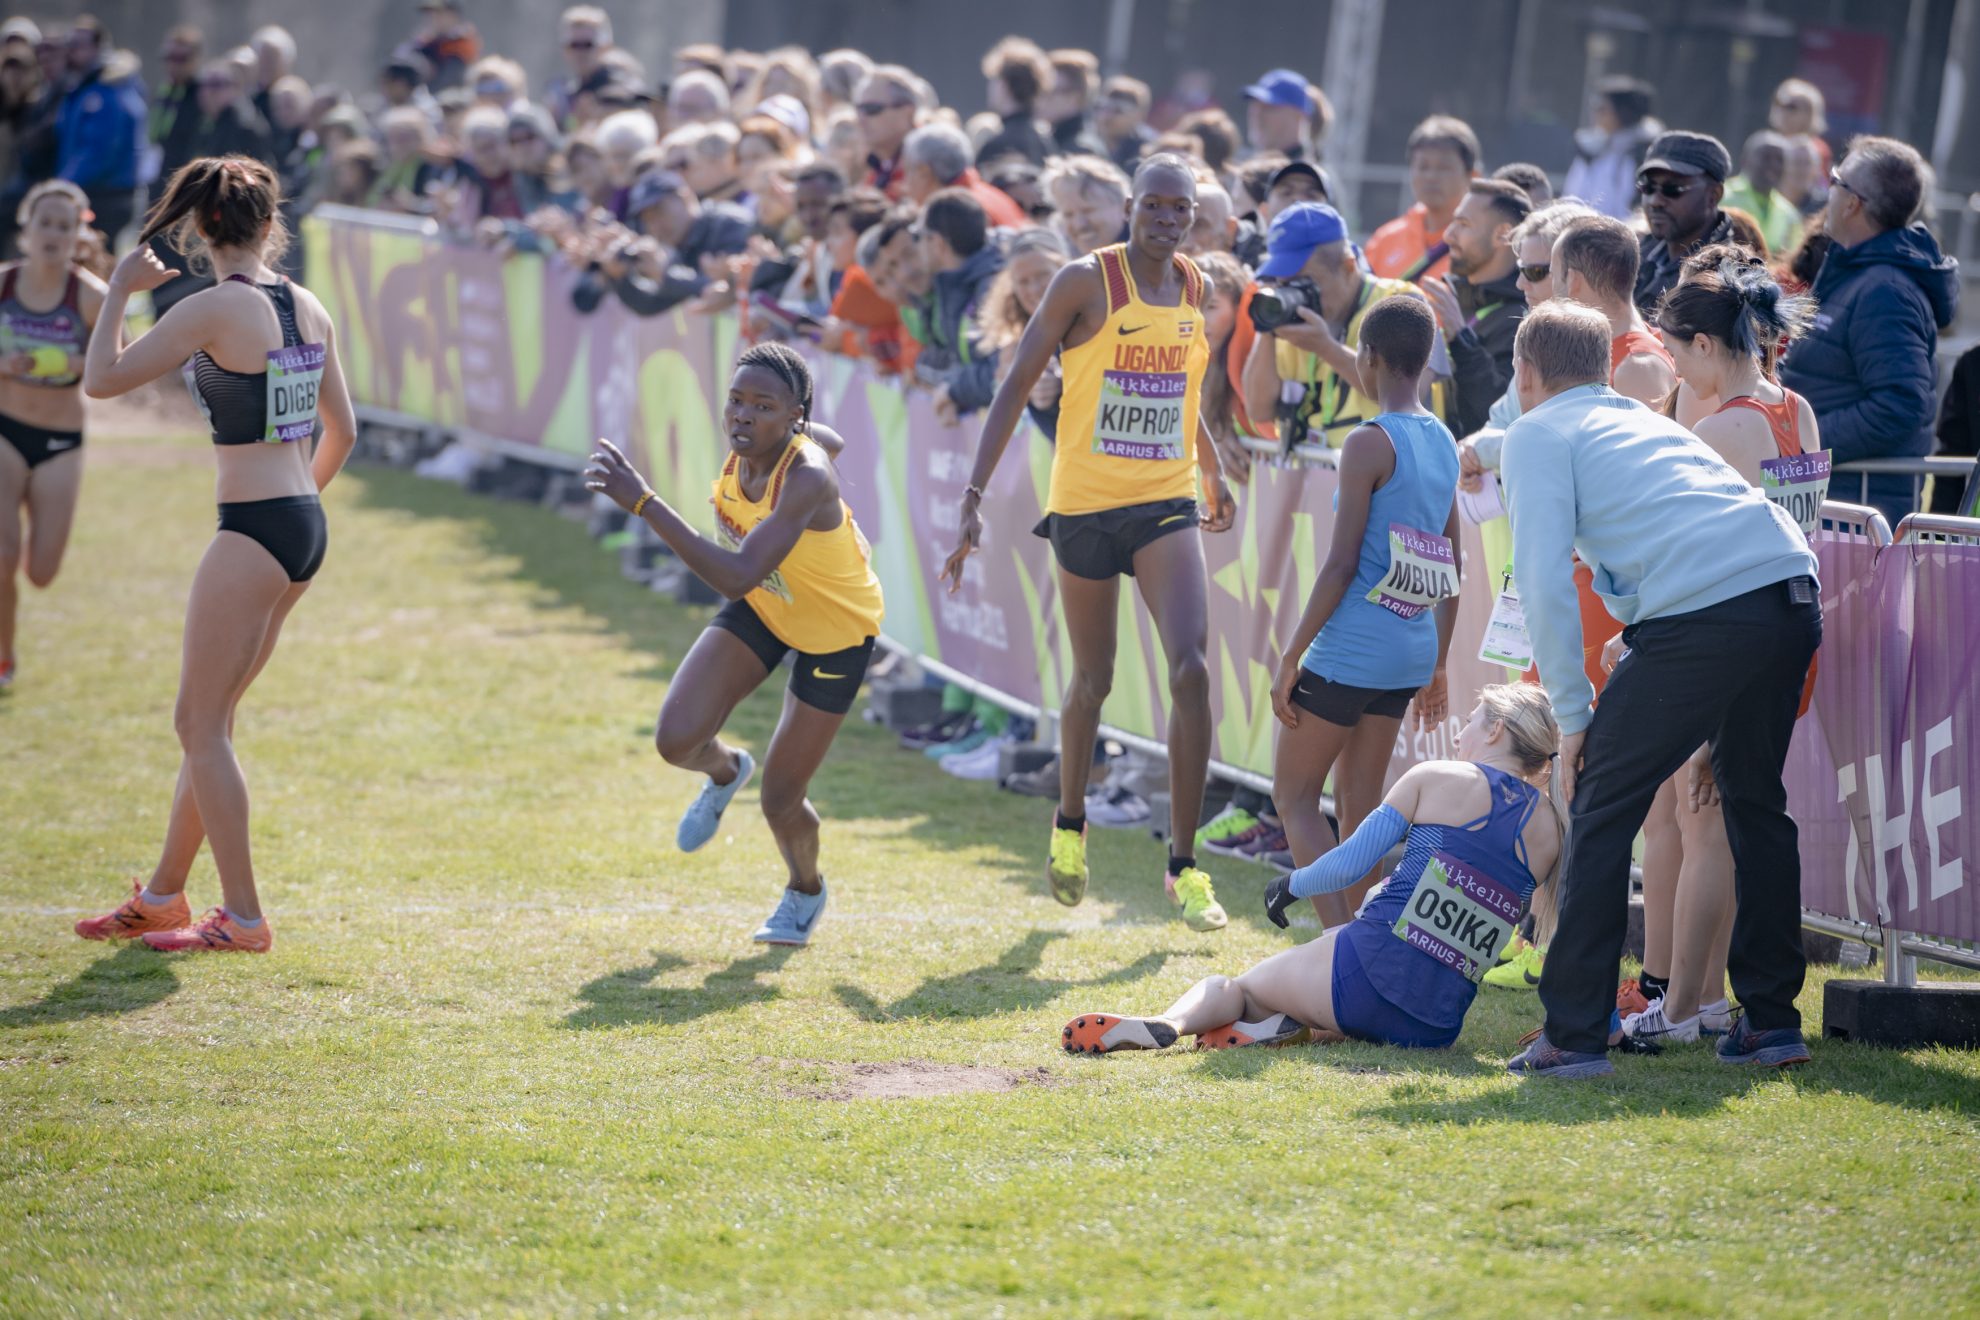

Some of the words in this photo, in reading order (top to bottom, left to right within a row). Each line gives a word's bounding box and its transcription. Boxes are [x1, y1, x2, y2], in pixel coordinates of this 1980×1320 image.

[275, 379, 321, 416] DIGB
[1105, 377, 1186, 393] Mikkeller
[1100, 403, 1180, 435] KIPROP
[1097, 440, 1154, 458] AARHUS
[1764, 460, 1829, 480] Mikkeller
[1391, 531, 1452, 558] Mikkeller
[1387, 560, 1453, 599] MBUA
[1838, 715, 1963, 925] THE
[1432, 858, 1520, 918] Mikkeller
[1414, 888, 1500, 959] OSIKA
[1400, 926, 1456, 963] AARHUS
